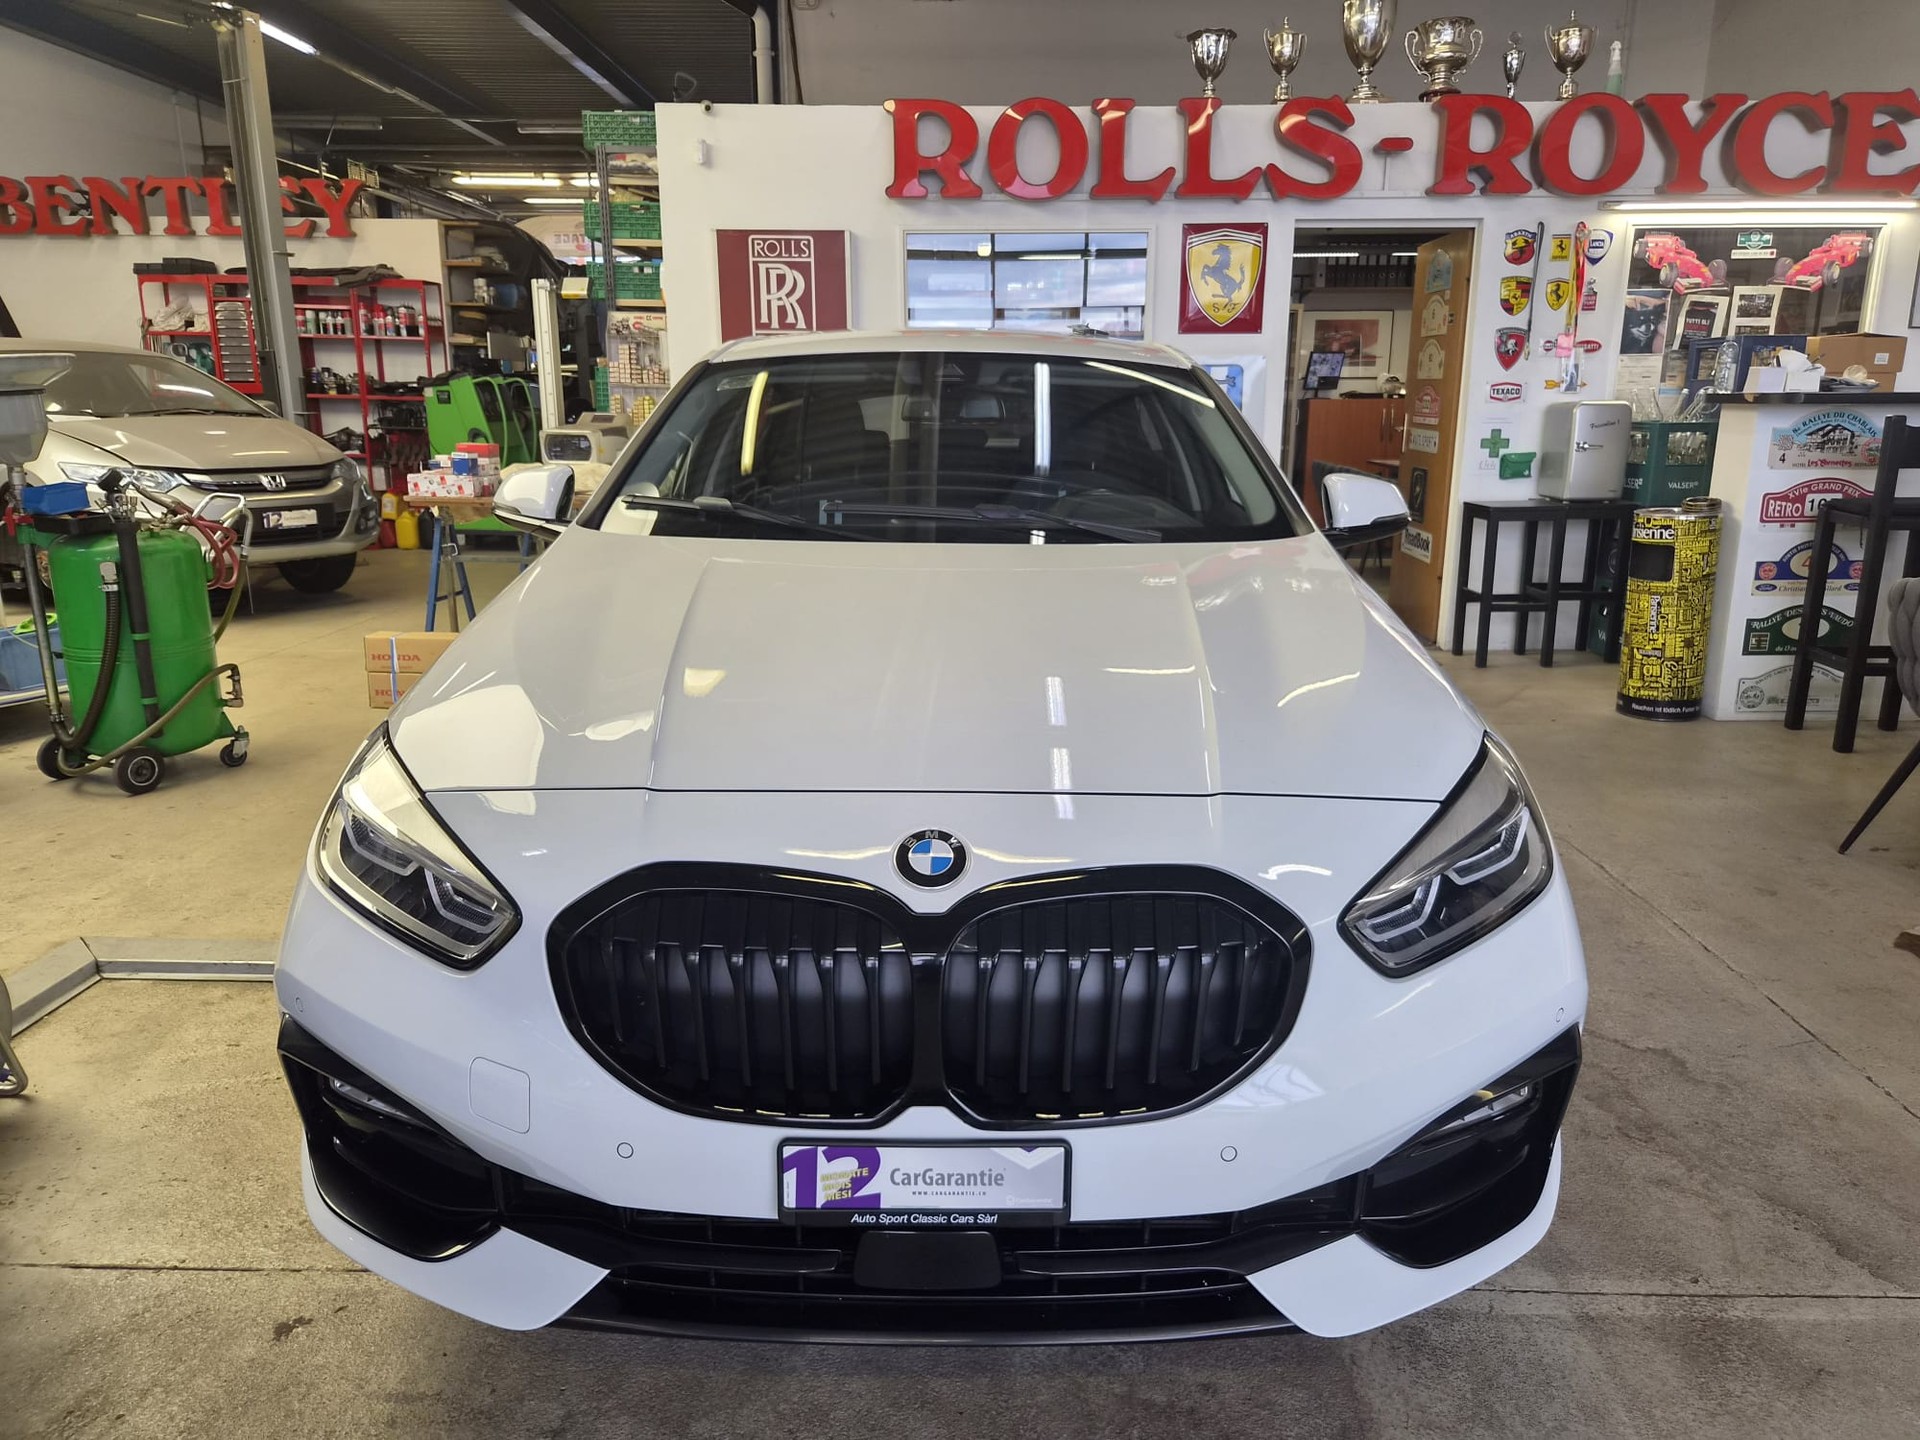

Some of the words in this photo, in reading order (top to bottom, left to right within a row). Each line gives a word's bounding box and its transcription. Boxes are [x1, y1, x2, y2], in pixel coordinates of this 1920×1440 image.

[753, 239, 810, 257] ROLLS
[1491, 386, 1521, 395] TEXACO
[1802, 412, 1831, 427] RALLYE
[1833, 411, 1846, 419] DU
[1847, 413, 1878, 438] CHABLAIS
[1779, 452, 1786, 464] 4
[1811, 482, 1843, 491] GRAND
[1843, 484, 1861, 498] PRIX
[1767, 500, 1802, 518] RETRO
[1751, 613, 1783, 630] RALLYE
[1784, 607, 1804, 618] DES
[1829, 611, 1855, 628] VAUDO
[372, 654, 421, 662] HODA
[903, 830, 961, 849] BMW
[783, 1146, 881, 1208] 12
[890, 1168, 1005, 1187] CarGarantie
[825, 1189, 852, 1201] MESI
[851, 1213, 877, 1224] Auto
[879, 1213, 908, 1225] Sport
[910, 1213, 948, 1224] Classic
[950, 1213, 975, 1224] Cars
